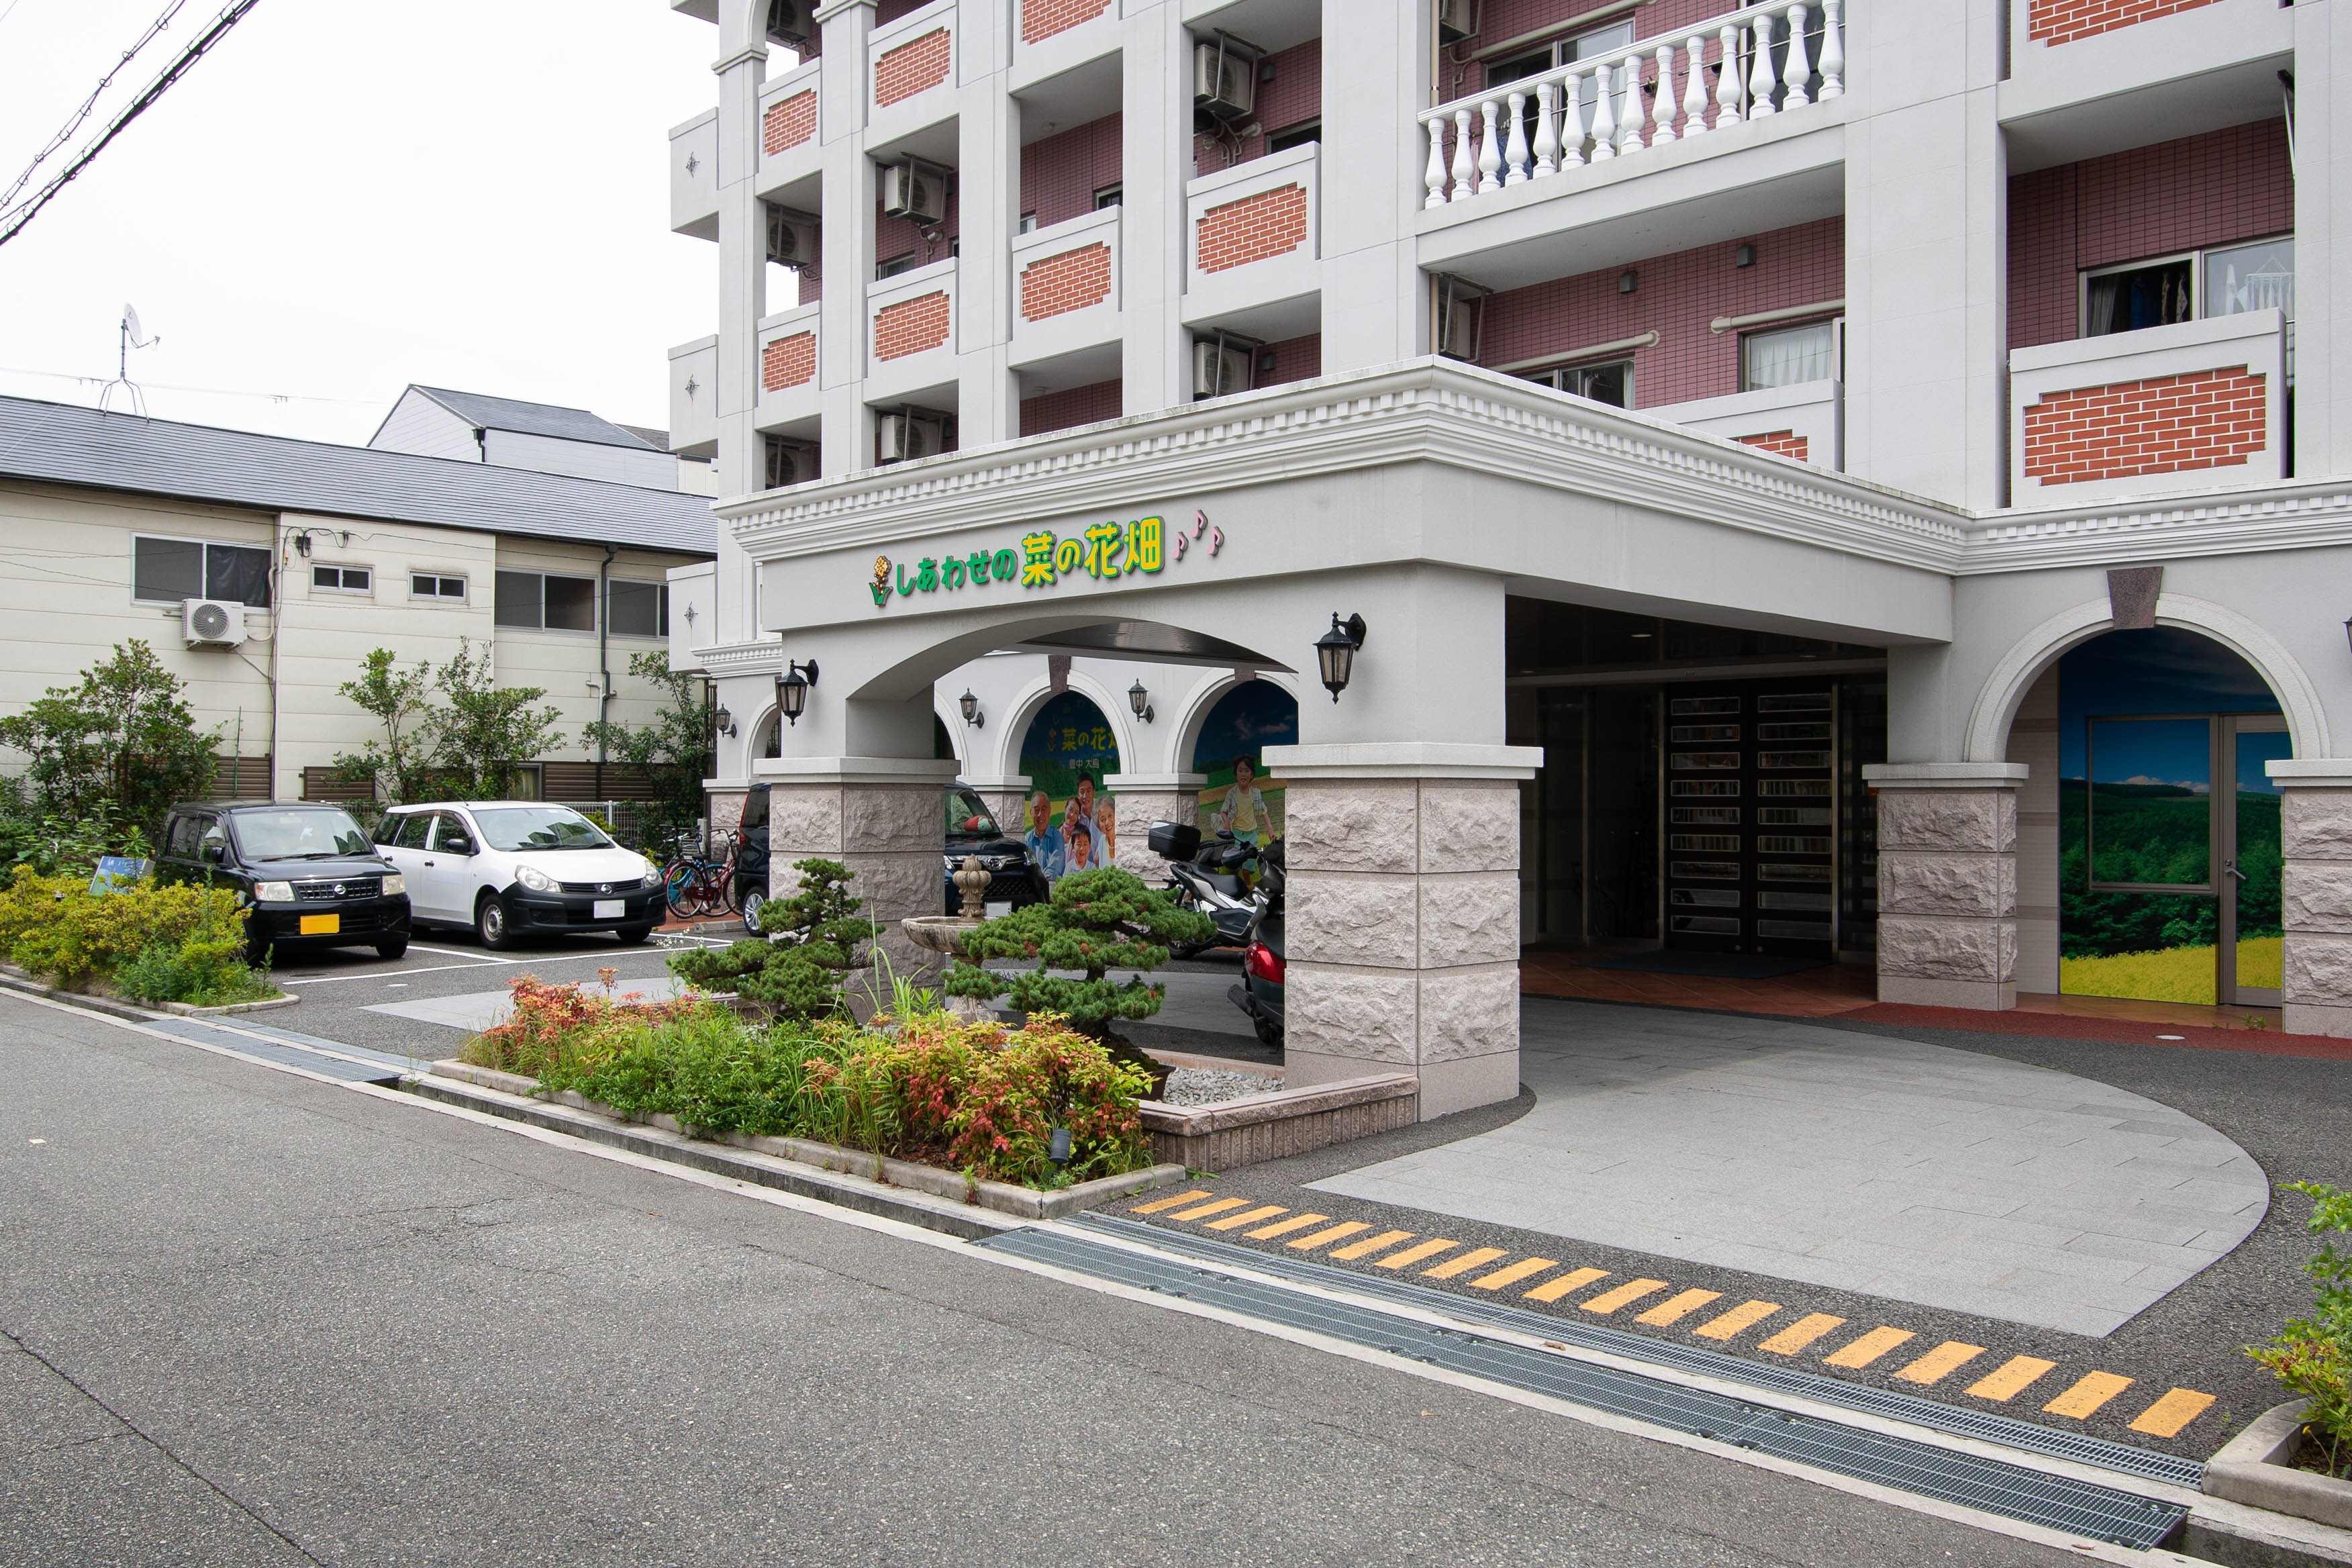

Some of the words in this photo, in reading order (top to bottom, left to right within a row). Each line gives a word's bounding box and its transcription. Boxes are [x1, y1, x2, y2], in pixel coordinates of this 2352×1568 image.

[896, 516, 1165, 596] しあわせの菜の花畑
